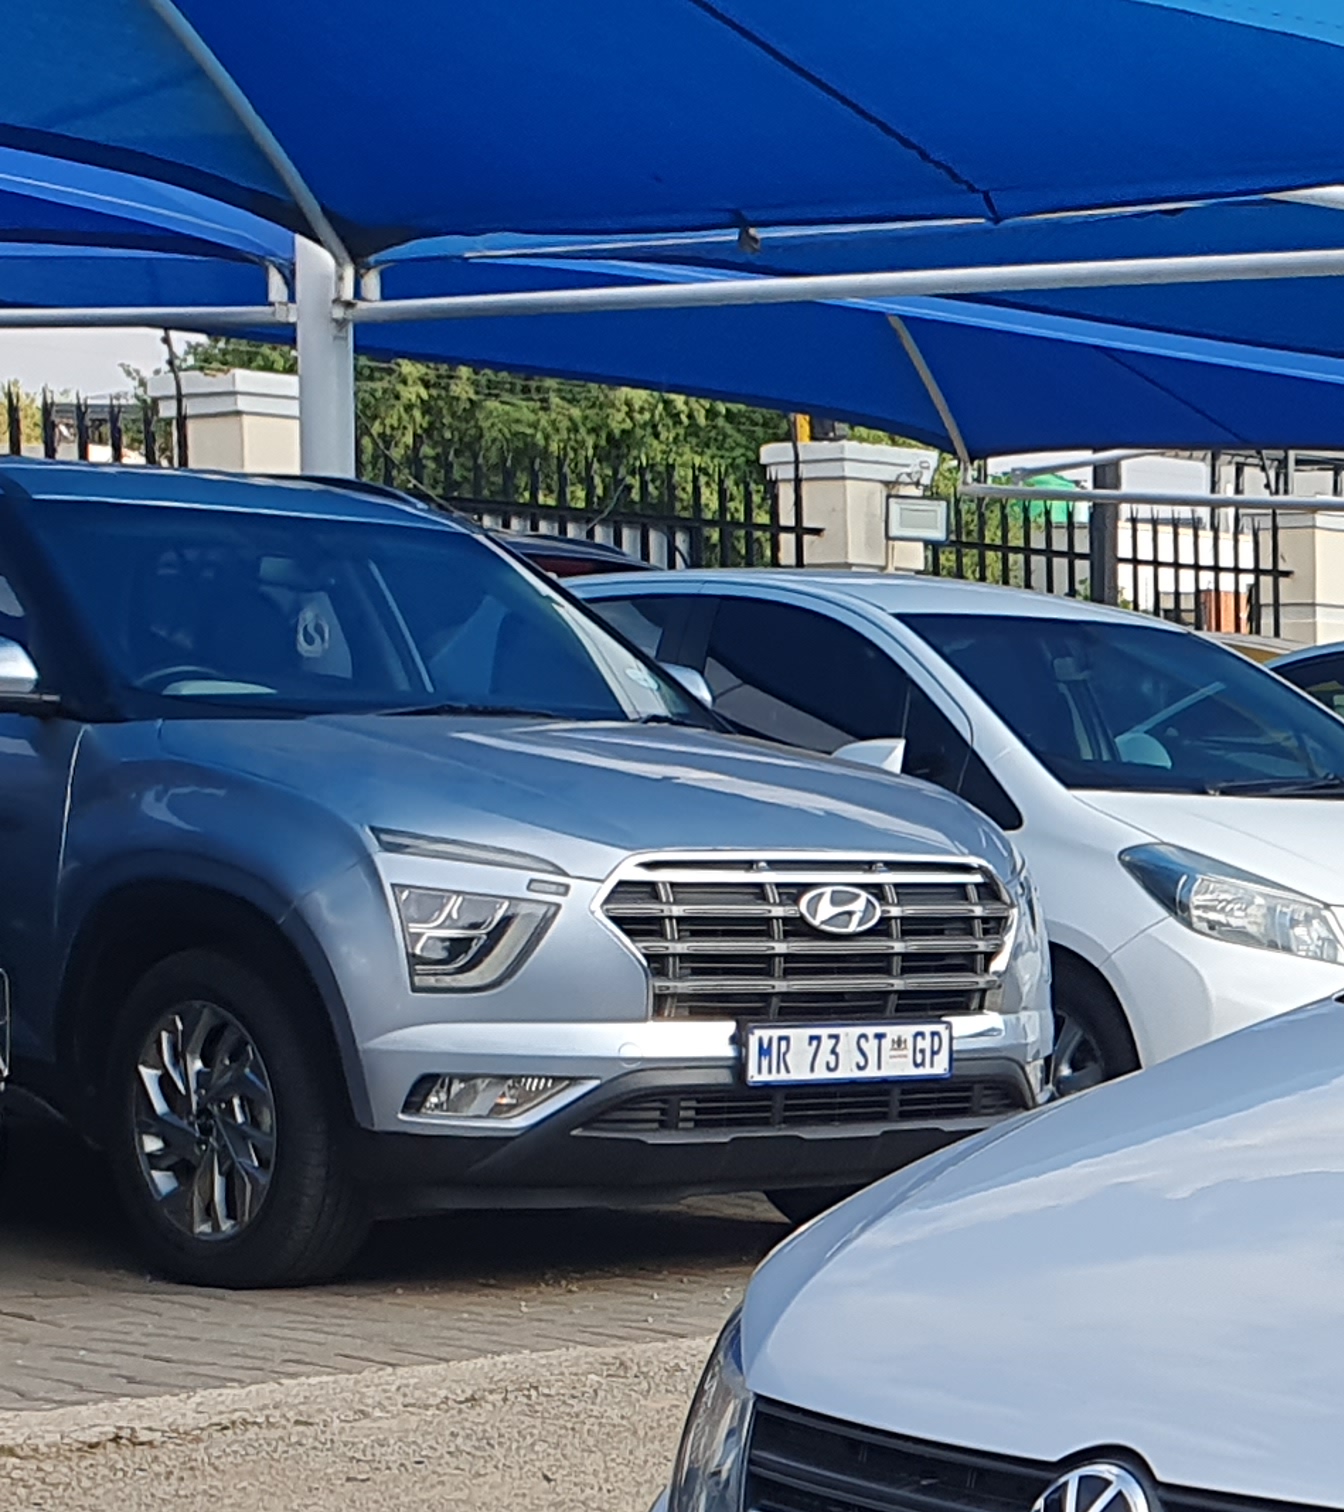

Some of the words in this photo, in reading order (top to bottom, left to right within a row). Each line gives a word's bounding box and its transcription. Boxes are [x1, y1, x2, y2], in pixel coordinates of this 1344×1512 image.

[757, 1035, 791, 1075] MR
[808, 1033, 841, 1074] 73
[855, 1031, 887, 1072] ST
[912, 1030, 943, 1069] GP
